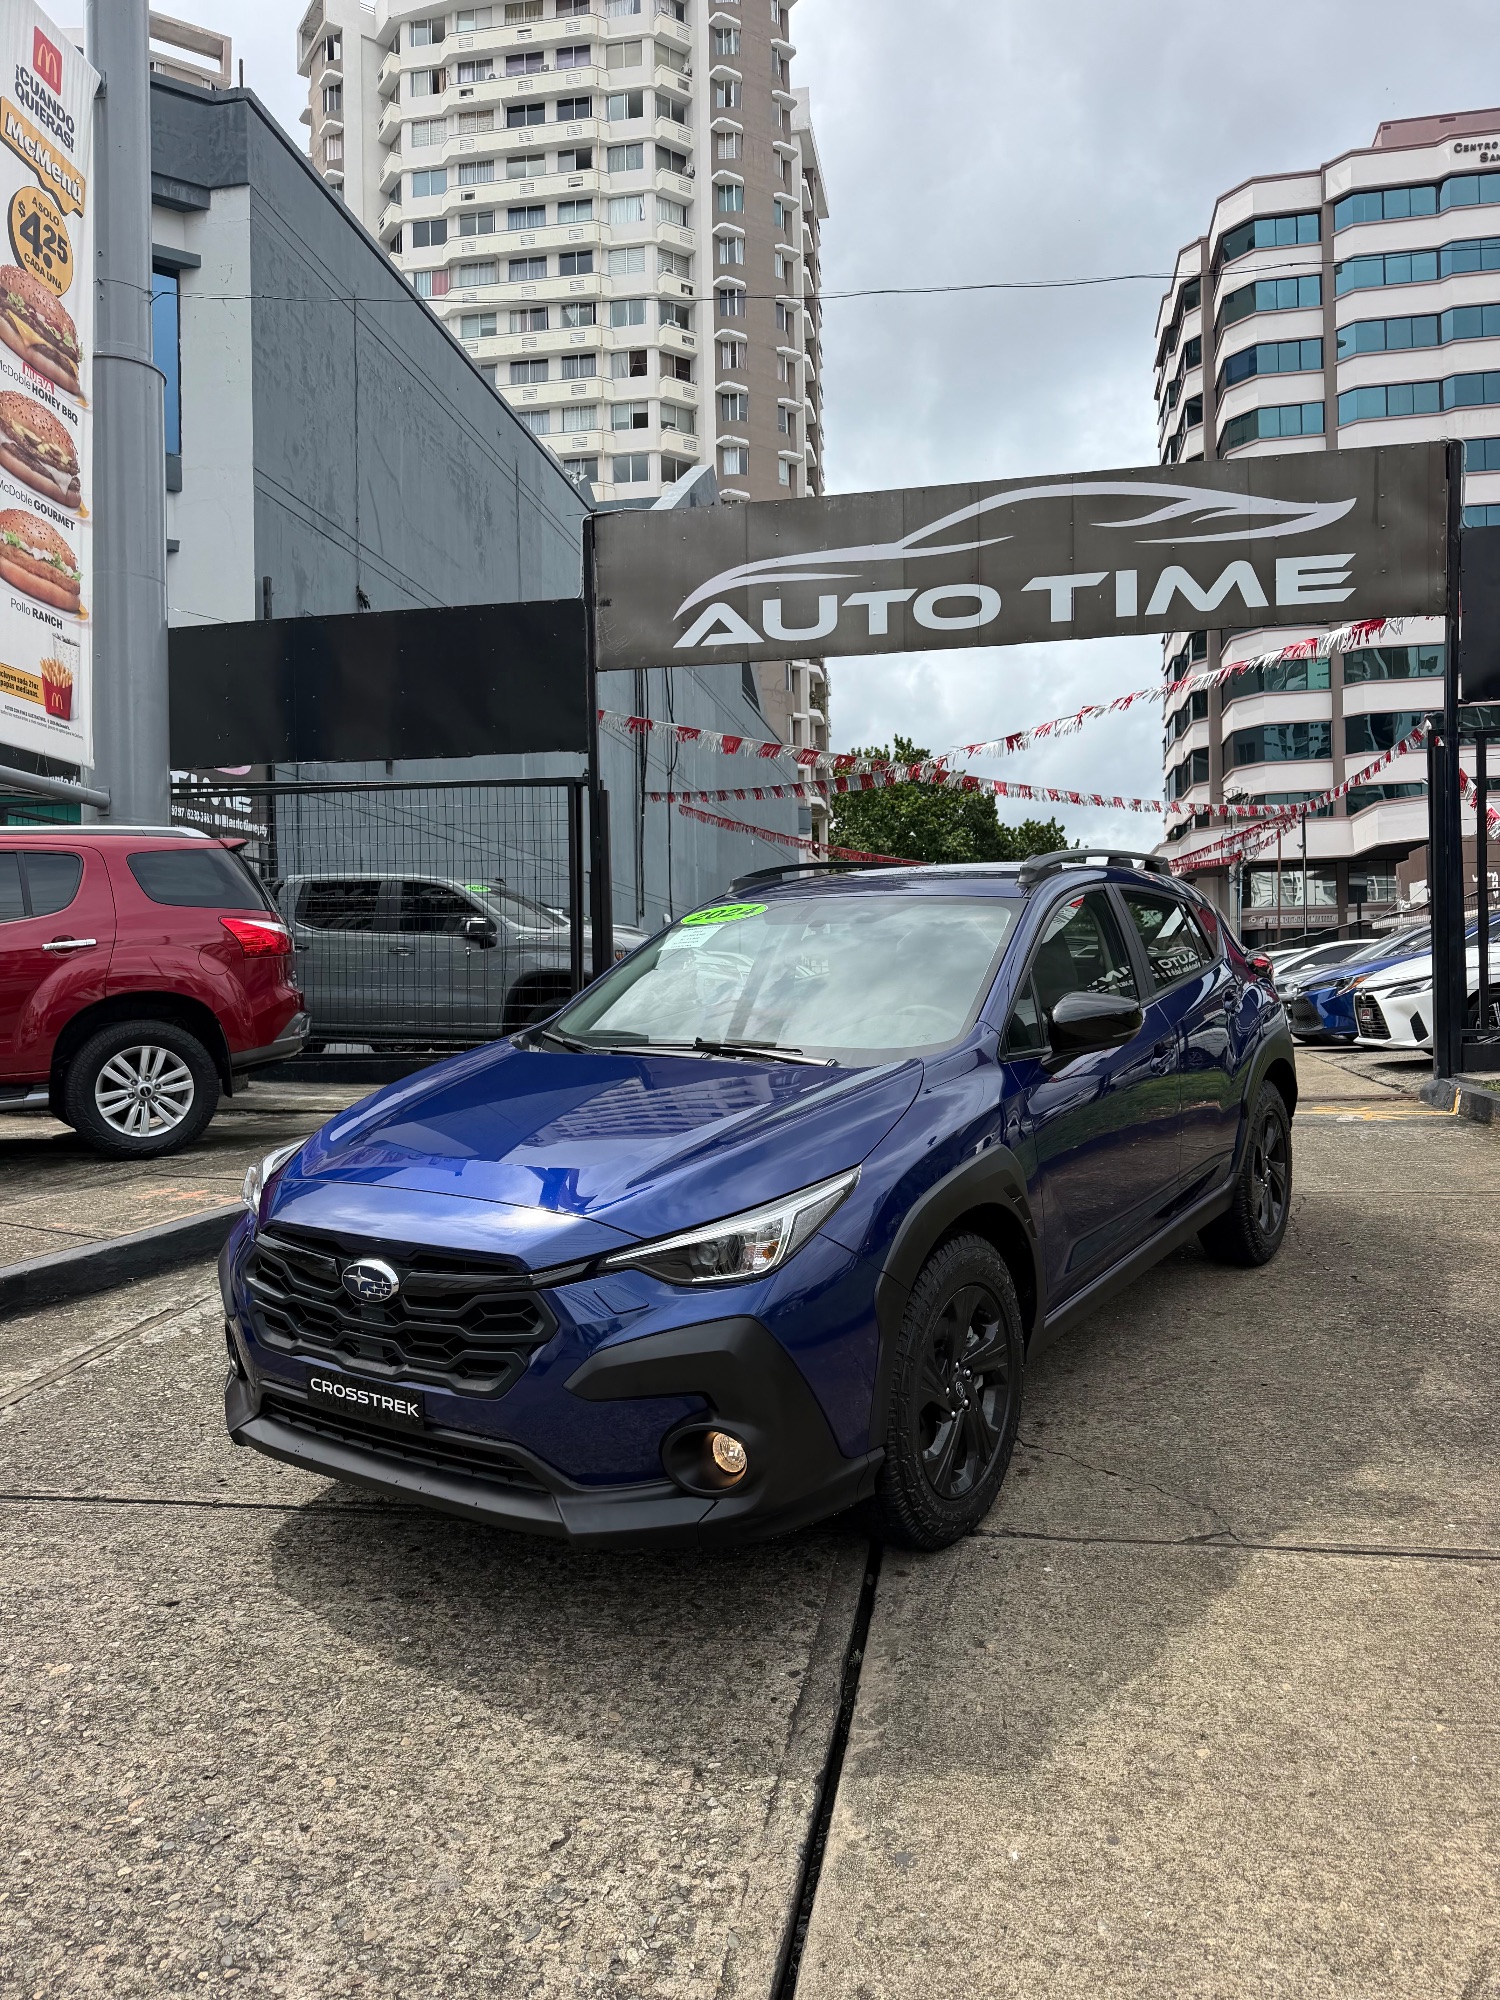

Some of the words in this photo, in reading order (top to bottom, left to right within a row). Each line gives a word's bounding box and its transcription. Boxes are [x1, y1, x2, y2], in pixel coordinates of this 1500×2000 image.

[15, 85, 75, 153] QUIERAS!
[5, 112, 82, 206] McMenú
[38, 203, 60, 226] SOLO
[24, 252, 45, 278] CADA
[46, 270, 62, 292] UNA
[24, 363, 53, 394] NUEVA
[32, 383, 61, 411] HONEY
[62, 403, 78, 426] BBQ
[34, 500, 75, 530] GOURMET
[10, 598, 31, 616] Pollo
[32, 607, 63, 630] RANCH
[673, 583, 1002, 649] AUTO
[1021, 553, 1357, 623] TIME
[686, 905, 762, 923] 2024
[310, 1377, 420, 1418] CROSSTREK
